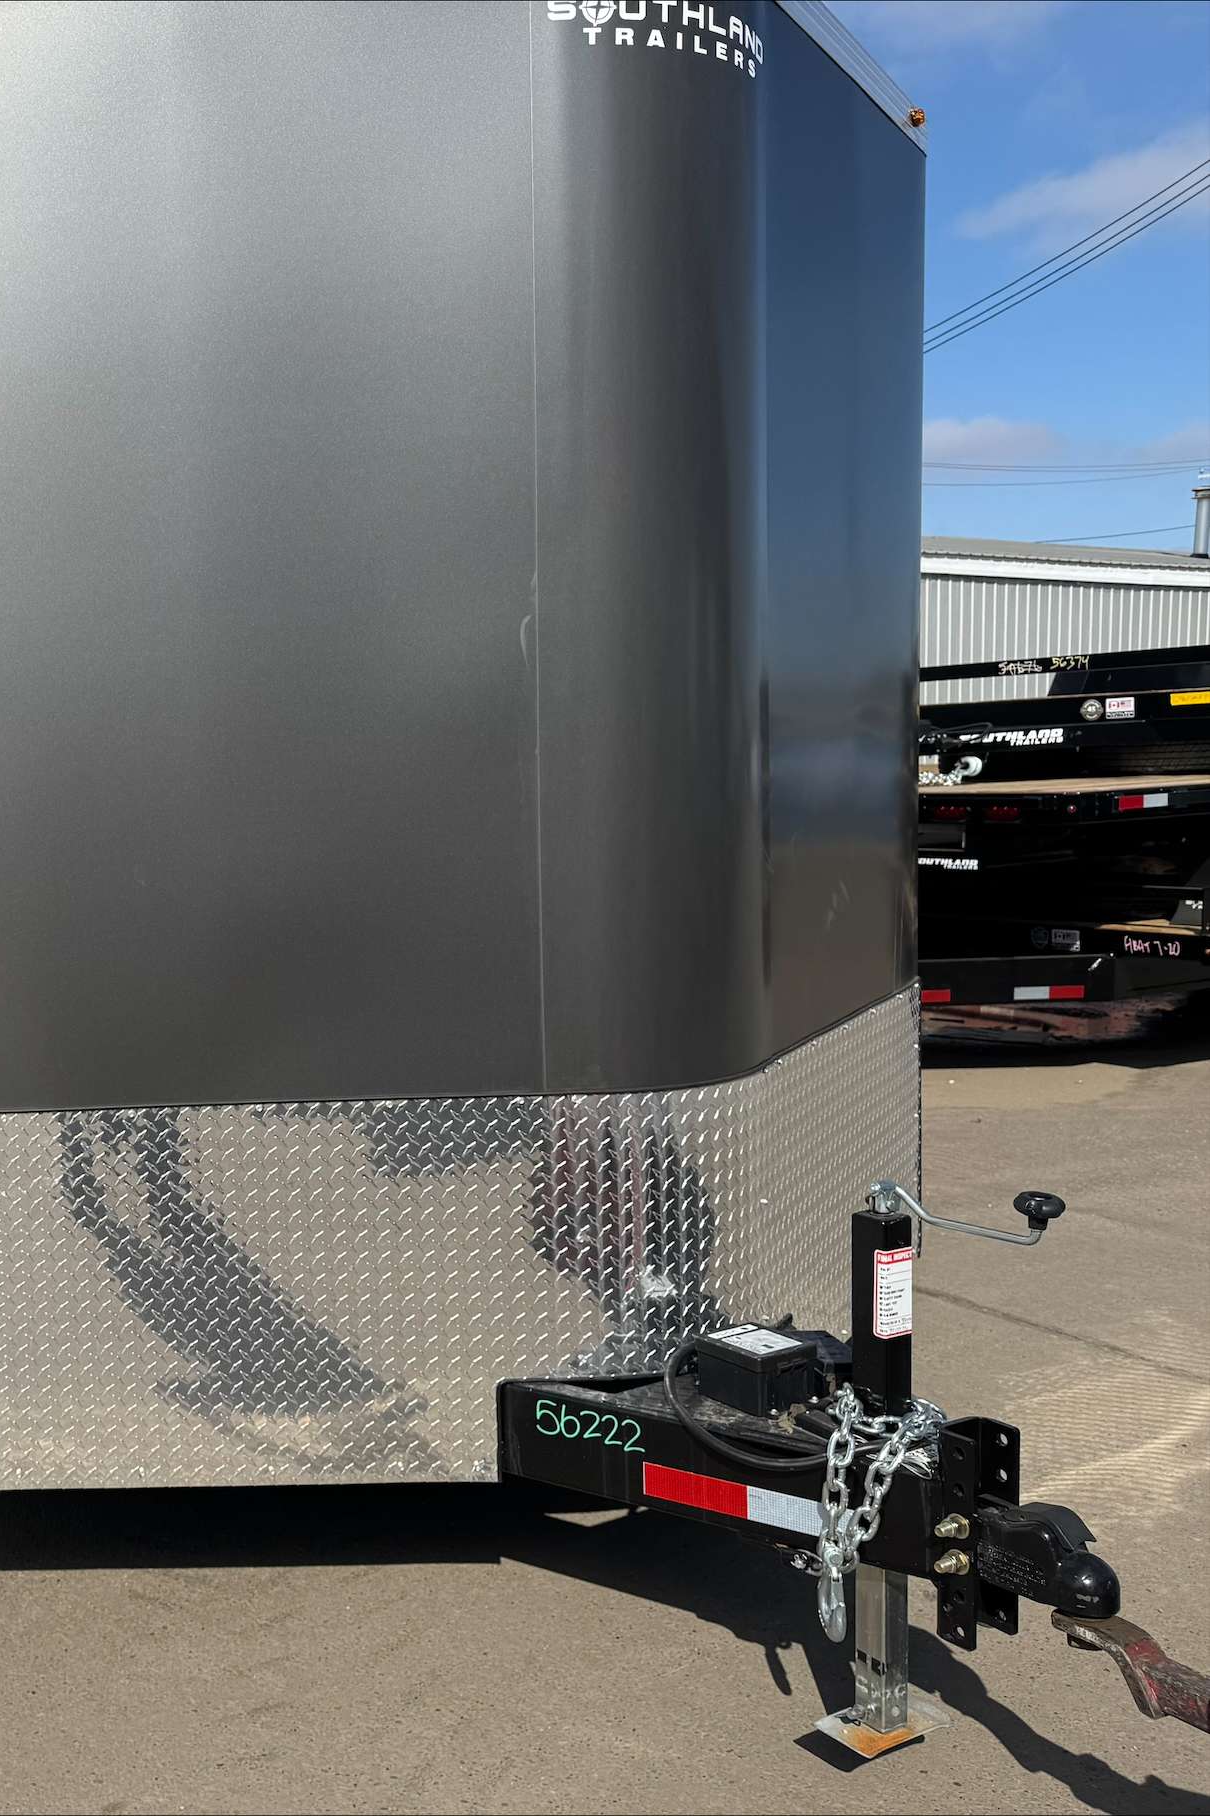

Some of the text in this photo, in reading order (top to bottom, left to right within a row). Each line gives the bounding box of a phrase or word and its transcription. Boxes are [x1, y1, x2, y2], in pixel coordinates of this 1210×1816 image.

[547, 1, 764, 65] SOUTHLAND
[583, 27, 757, 78] TRAILERS
[1050, 655, 1090, 670] 56374
[918, 857, 979, 866] OUTHLAND
[536, 1399, 645, 1453] 56222
